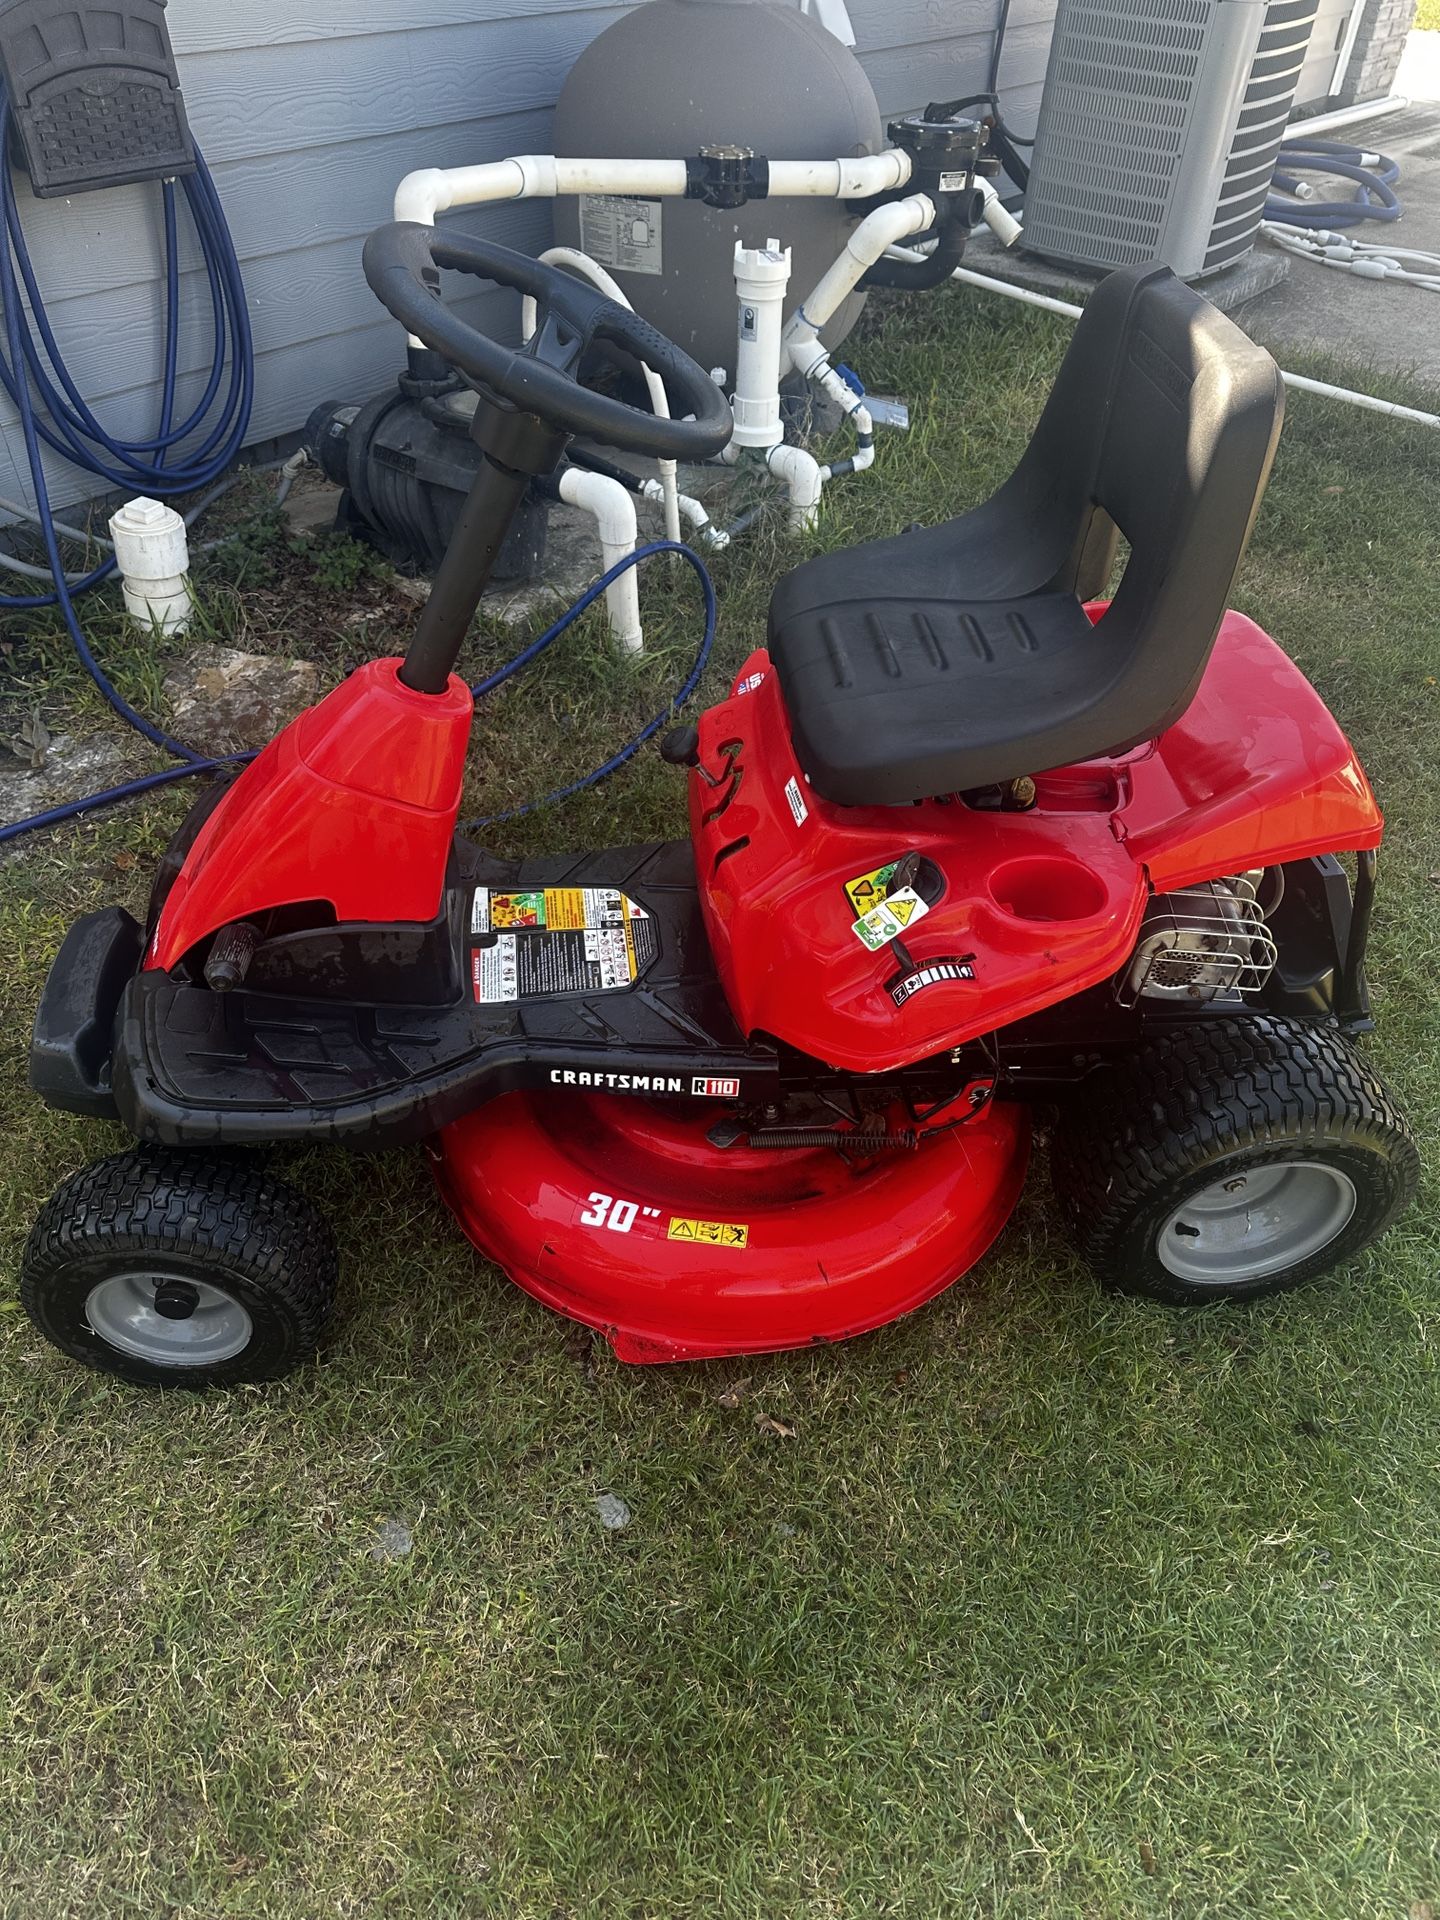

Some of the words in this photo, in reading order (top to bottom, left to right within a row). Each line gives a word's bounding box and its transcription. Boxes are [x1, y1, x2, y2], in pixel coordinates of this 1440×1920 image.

[550, 1069, 682, 1092] CRAFTSMAN
[692, 1078, 735, 1096] R110
[580, 1192, 661, 1233] 30"
